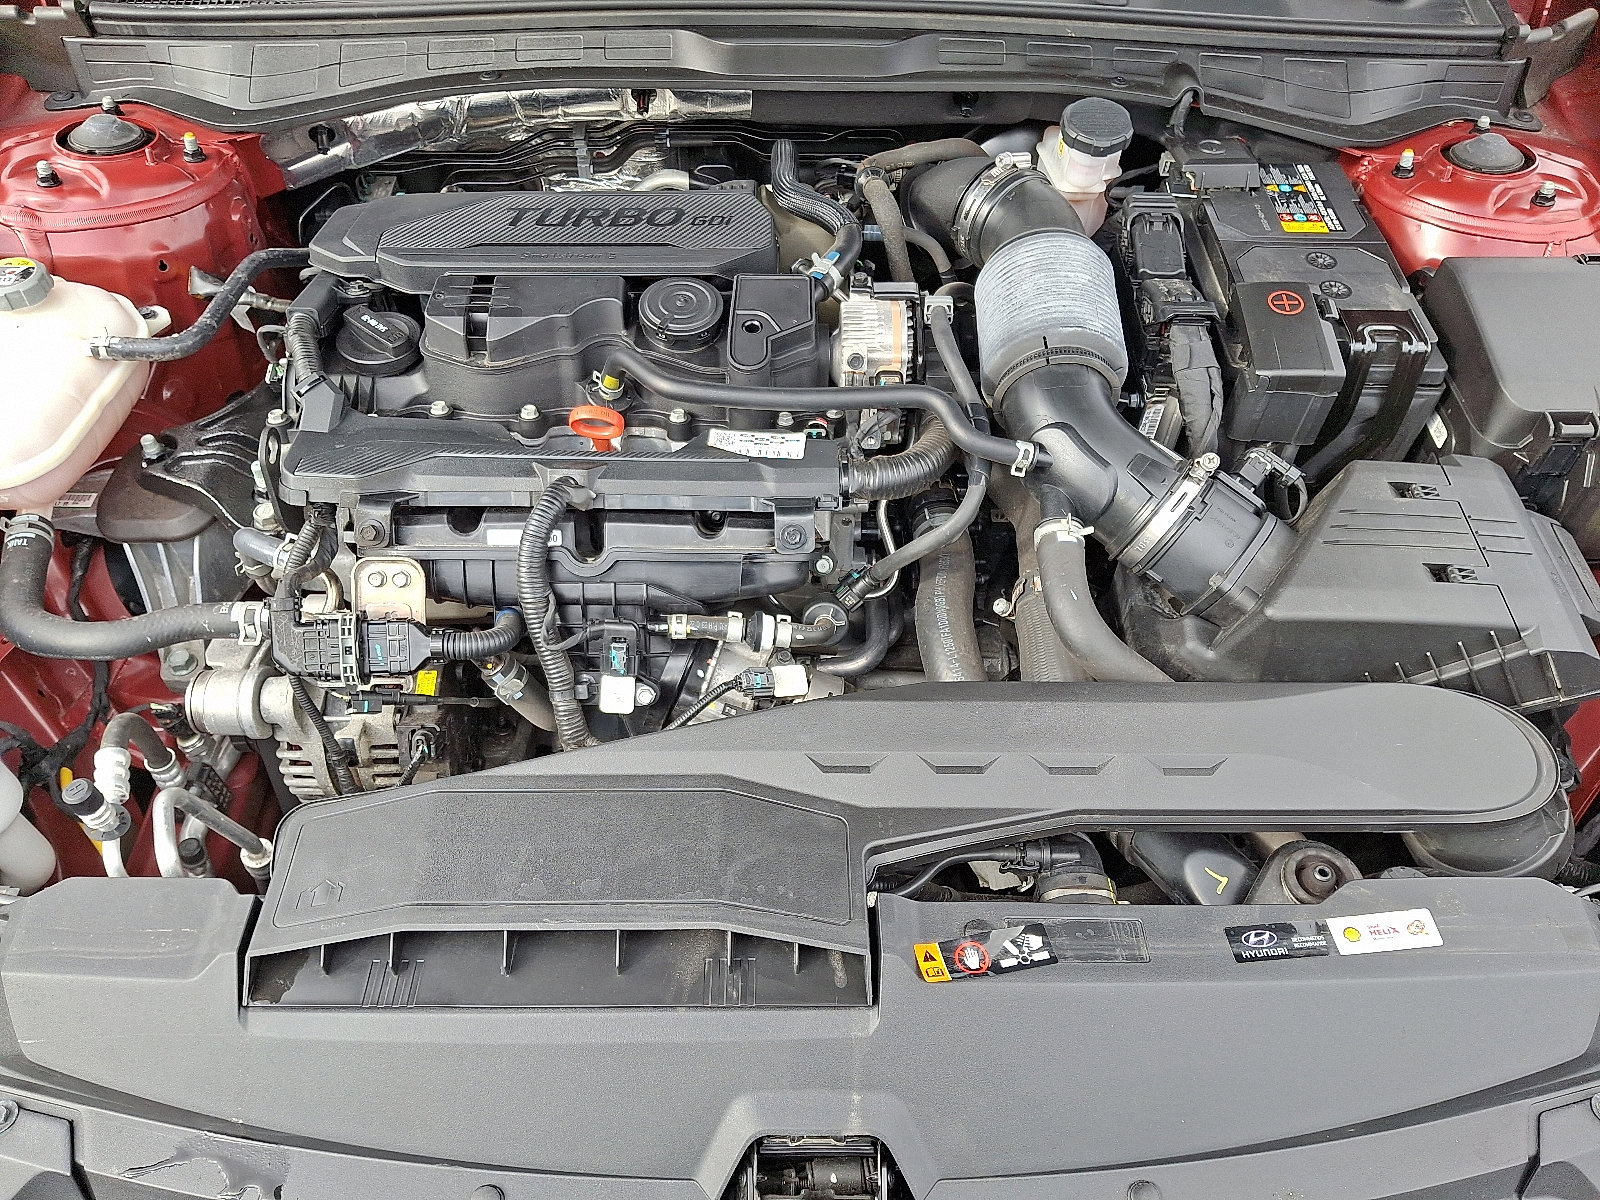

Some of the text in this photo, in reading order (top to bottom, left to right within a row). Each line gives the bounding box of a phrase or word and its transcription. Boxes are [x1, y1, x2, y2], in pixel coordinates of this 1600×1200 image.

[506, 206, 686, 228] TURBO
[1369, 926, 1400, 936] HELIX
[1241, 947, 1290, 959] HYUNDAI
